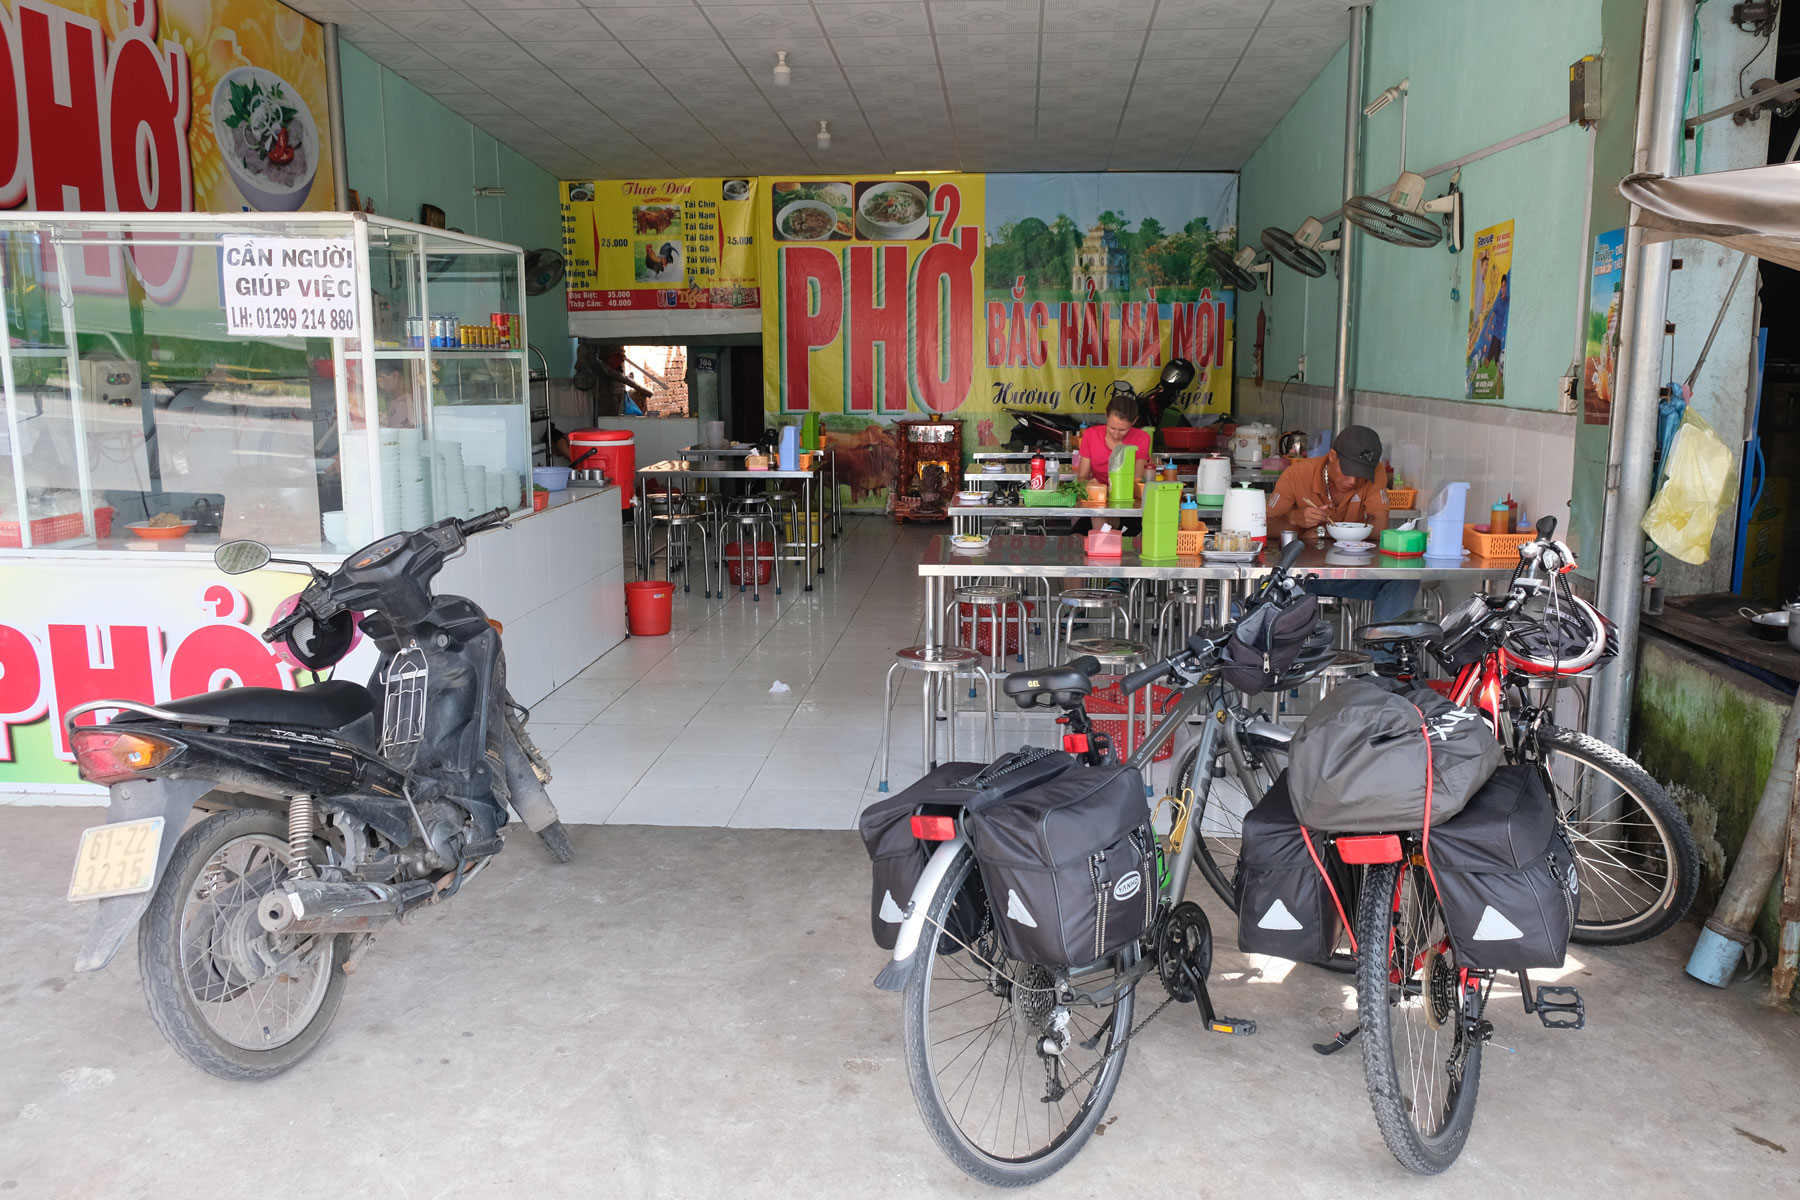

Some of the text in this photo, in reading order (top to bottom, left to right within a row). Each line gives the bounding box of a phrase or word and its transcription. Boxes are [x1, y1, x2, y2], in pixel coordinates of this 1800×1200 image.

[226, 240, 352, 268] CẦN NGƯỜI
[601, 238, 628, 247] 25.000
[235, 272, 352, 302] GIÚP VIỆC
[780, 183, 979, 414] PHỞ
[231, 306, 354, 330] LH: 01299 214 880
[608, 299, 632, 307] 40.000
[987, 275, 1227, 384] BẮC HẢI HÀ NỘI
[991, 381, 1062, 410] Hương
[1069, 382, 1098, 411] Vị
[82, 858, 144, 892] 3235
